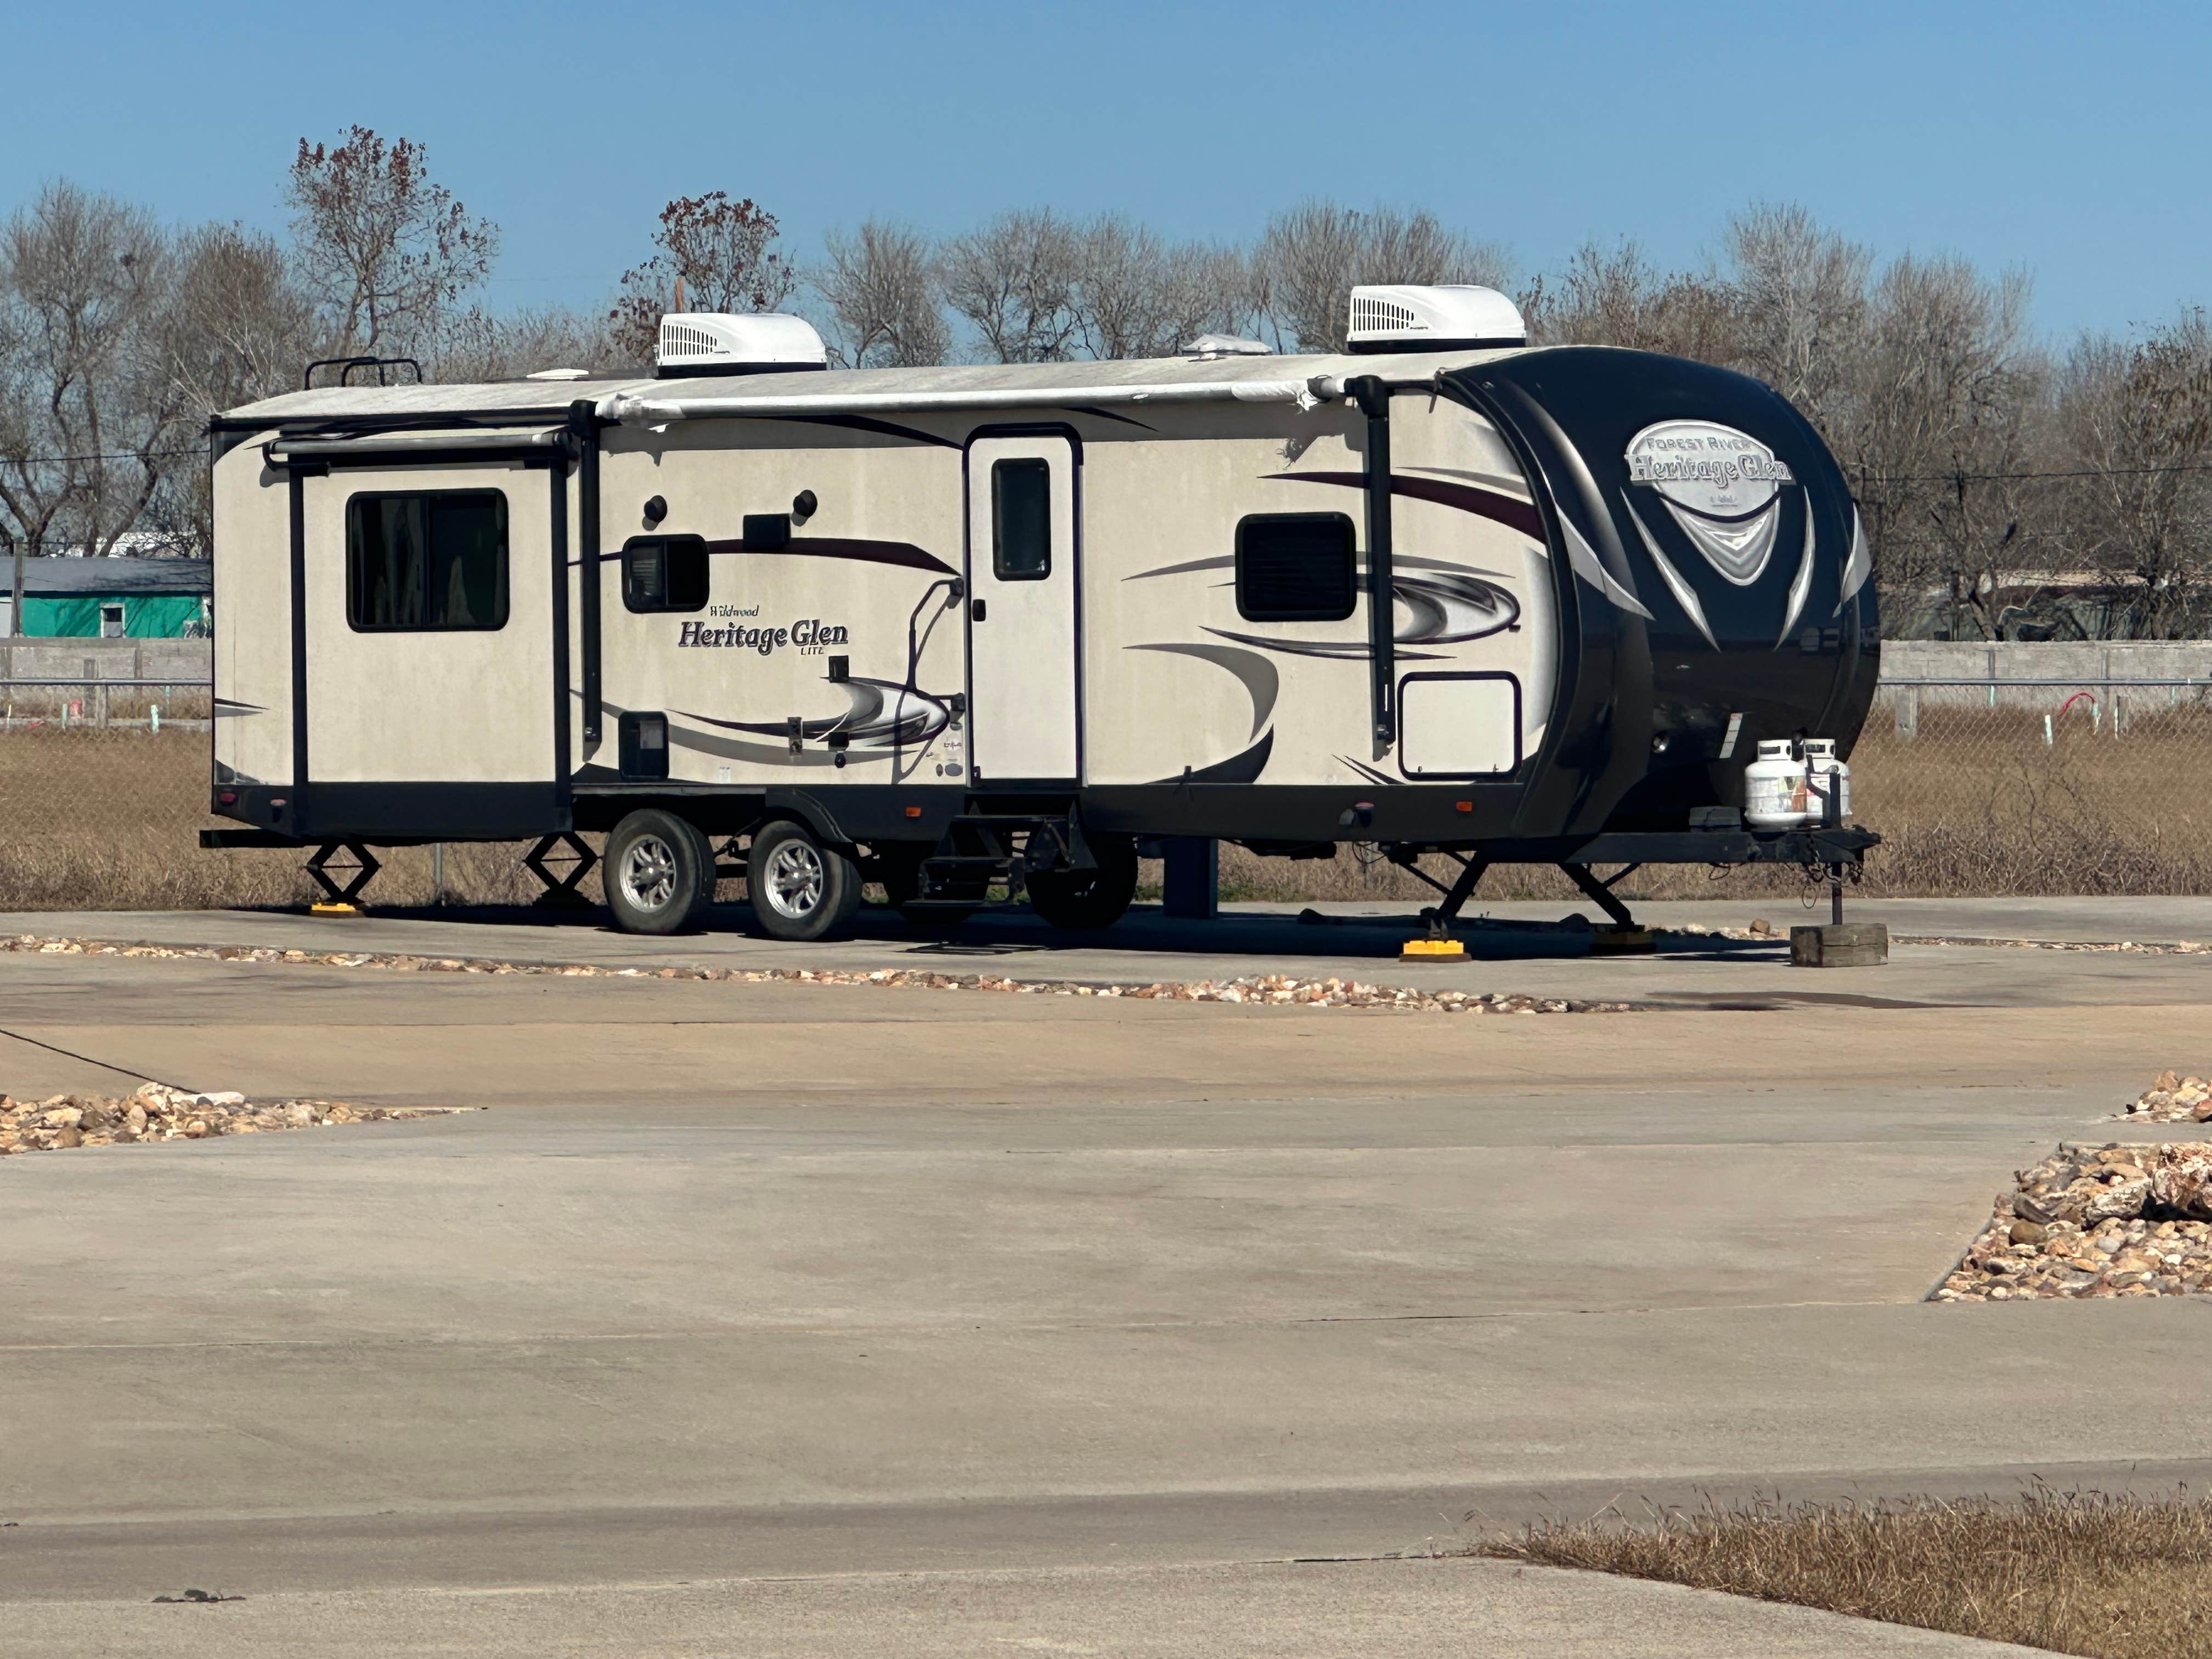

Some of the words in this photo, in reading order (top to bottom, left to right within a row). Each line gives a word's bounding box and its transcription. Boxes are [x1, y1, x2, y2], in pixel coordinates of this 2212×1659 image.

[1629, 455, 1739, 489] Heritage
[1736, 454, 1793, 481] Glen
[678, 620, 788, 656] Heritage
[791, 619, 849, 646] Glen
